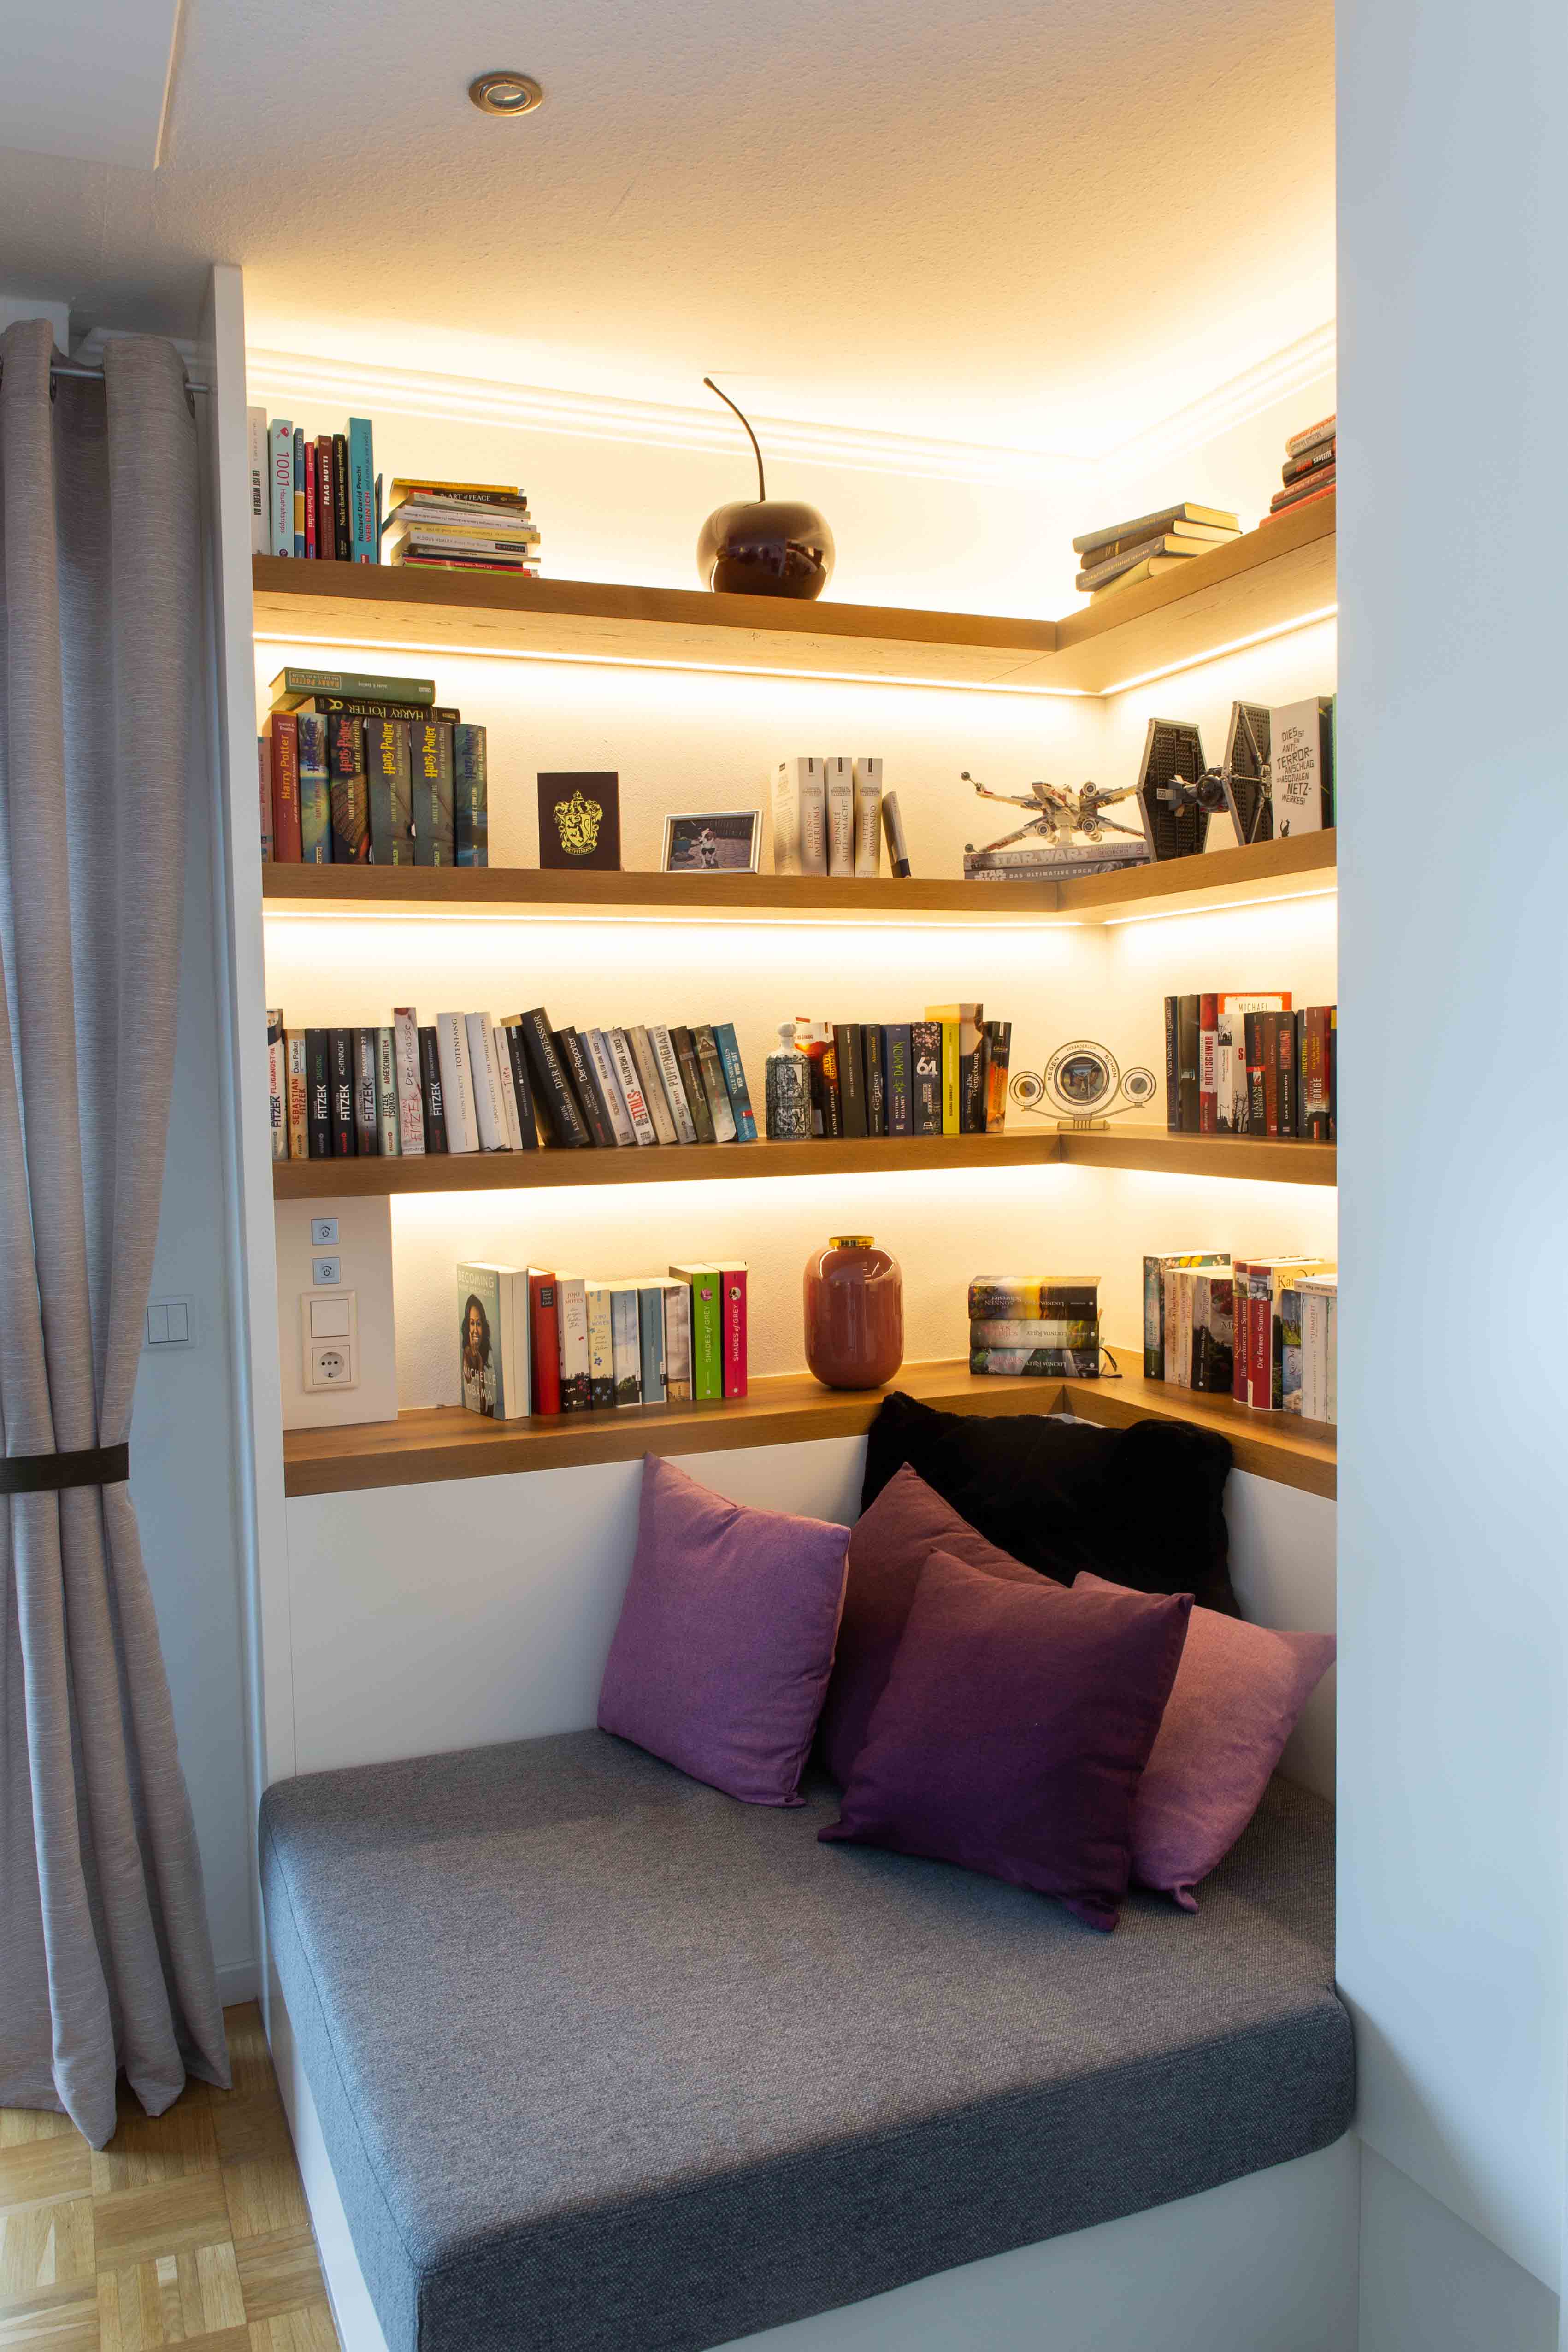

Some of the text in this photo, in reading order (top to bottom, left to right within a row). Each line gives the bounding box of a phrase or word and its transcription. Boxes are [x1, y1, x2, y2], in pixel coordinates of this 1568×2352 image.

[277, 452, 290, 487] 1001
[1314, 449, 1332, 464] Hitlers
[253, 488, 261, 507] WIEDER
[291, 677, 340, 688] HARRY POTTER
[349, 705, 423, 720] HARRY POTTER
[337, 719, 353, 772] Harry Potter
[380, 722, 396, 775] Harry Potter
[422, 726, 438, 778] Harry Potter
[1281, 727, 1297, 742] DIES
[1282, 743, 1298, 753] ANTI-
[280, 735, 292, 800] Harry Potter
[1276, 746, 1314, 770] TERROR-
[1284, 759, 1315, 775] ANSCHLAG
[1281, 772, 1309, 783] ASOZIALEN
[1287, 782, 1312, 796] NETZ-
[868, 805, 877, 857] KOMMANDO
[995, 847, 1091, 865] STAR WARS
[404, 1024, 413, 1063] Insasse
[451, 1018, 462, 1068] TOTENFANG
[483, 1039, 491, 1062] EWIGEN
[533, 1014, 564, 1089] DER PROFESSOR
[567, 1037, 587, 1082] Der Reporter
[656, 1031, 679, 1087] PUPPENGRAB
[893, 1040, 906, 1077] DÄMON
[1204, 1036, 1214, 1085] RÜTLISCHWUR
[1279, 1029, 1291, 1070] ILLUMINATI
[613, 1038, 634, 1086] CODY MCFADYEN
[724, 1048, 738, 1095] NELL NEUHAUS
[916, 1057, 938, 1078] 64
[971, 1052, 980, 1096] Vergebung
[1047, 1056, 1060, 1081] REGEN
[291, 1078, 300, 1125] SEBASTIAN
[317, 1084, 328, 1120] FITZEK
[339, 1084, 350, 1121] FITZEK
[363, 1082, 374, 1122] FITZEK
[431, 1082, 443, 1117] FITZEK
[627, 1091, 648, 1121] STILLE
[1313, 1077, 1322, 1109] GEORGE
[273, 1095, 282, 1128] FITZEK
[401, 1098, 410, 1138] SEBASTIAN
[408, 1093, 422, 1142] FITZEK
[560, 1105, 570, 1121] JOHN
[562, 1091, 580, 1132] KATZENBACH
[457, 1270, 495, 1289] BECOMING
[707, 1325, 713, 1334] of
[735, 1323, 740, 1333] of
[463, 1368, 497, 1386] MICHELLE
[467, 1383, 493, 1403] OBAMA
